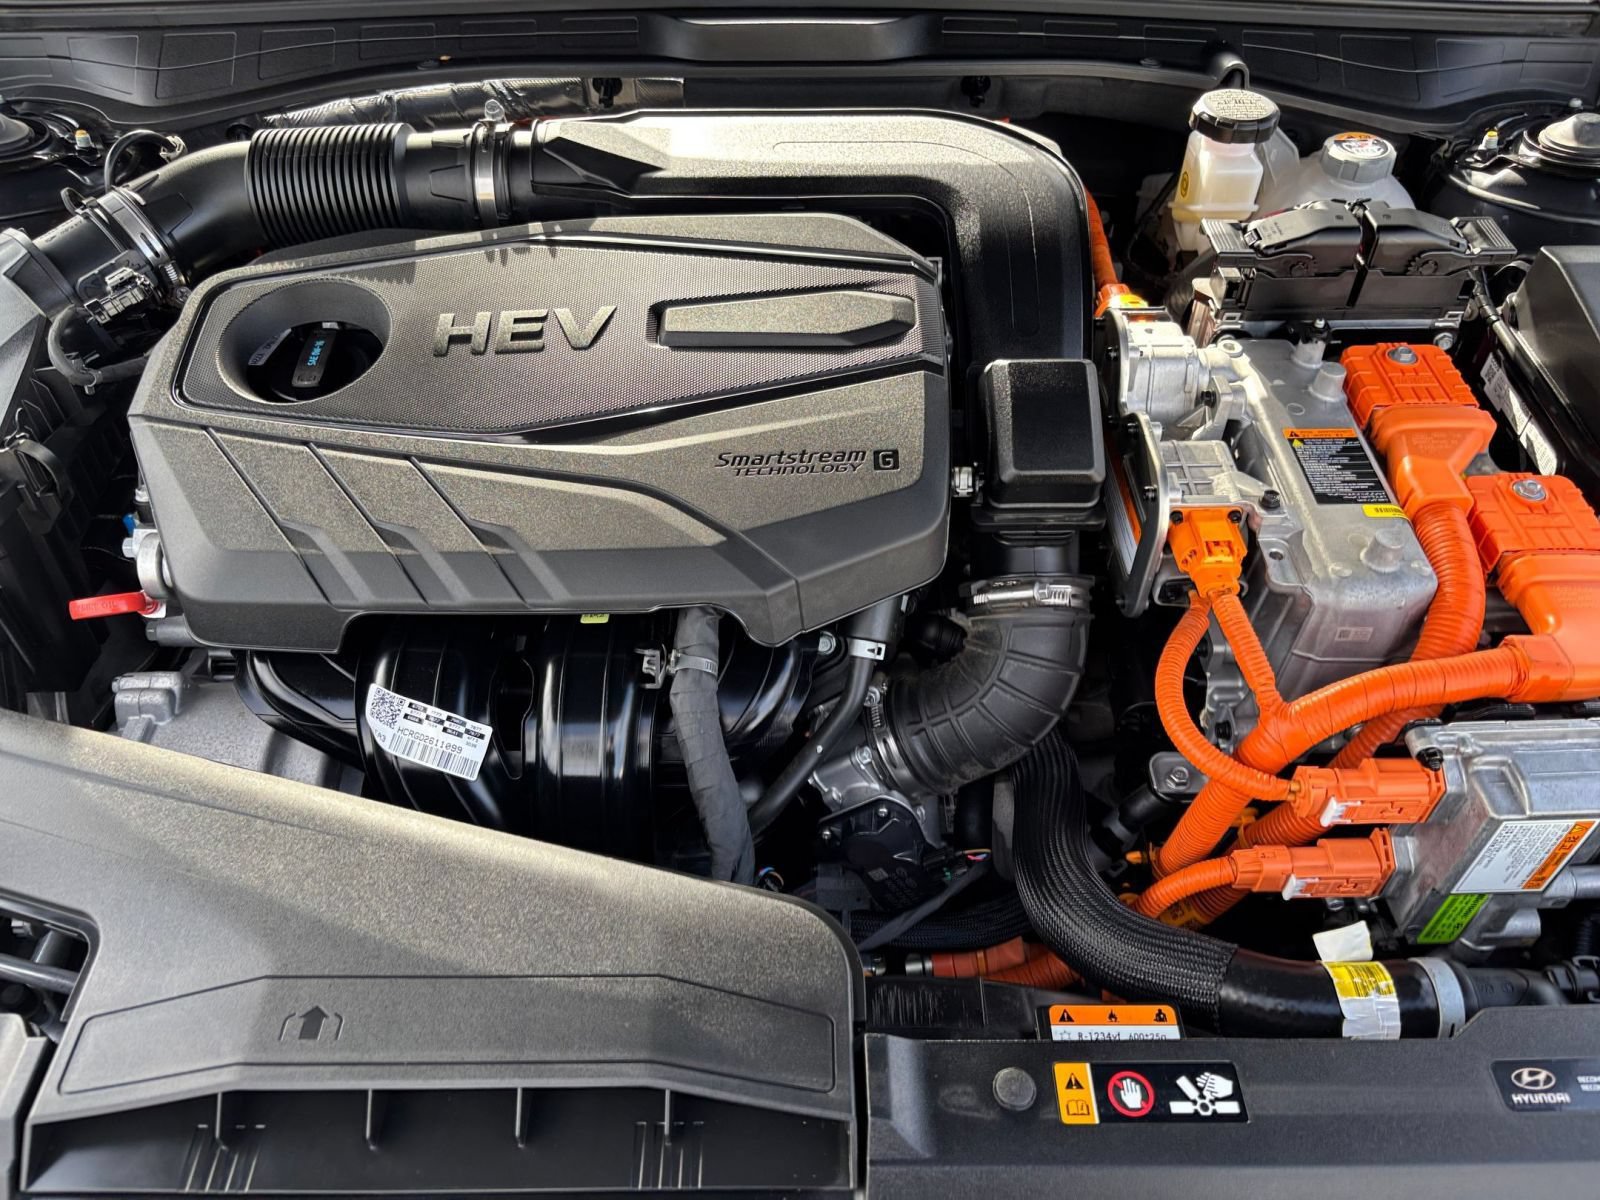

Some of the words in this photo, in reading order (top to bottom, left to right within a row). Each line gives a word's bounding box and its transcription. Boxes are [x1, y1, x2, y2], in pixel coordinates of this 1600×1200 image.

[433, 305, 617, 357] HEV
[714, 450, 867, 468] Smartstream
[876, 450, 897, 470] G
[733, 463, 864, 477] TECHNOLOGY
[1511, 1092, 1571, 1104] HYUNDAI
